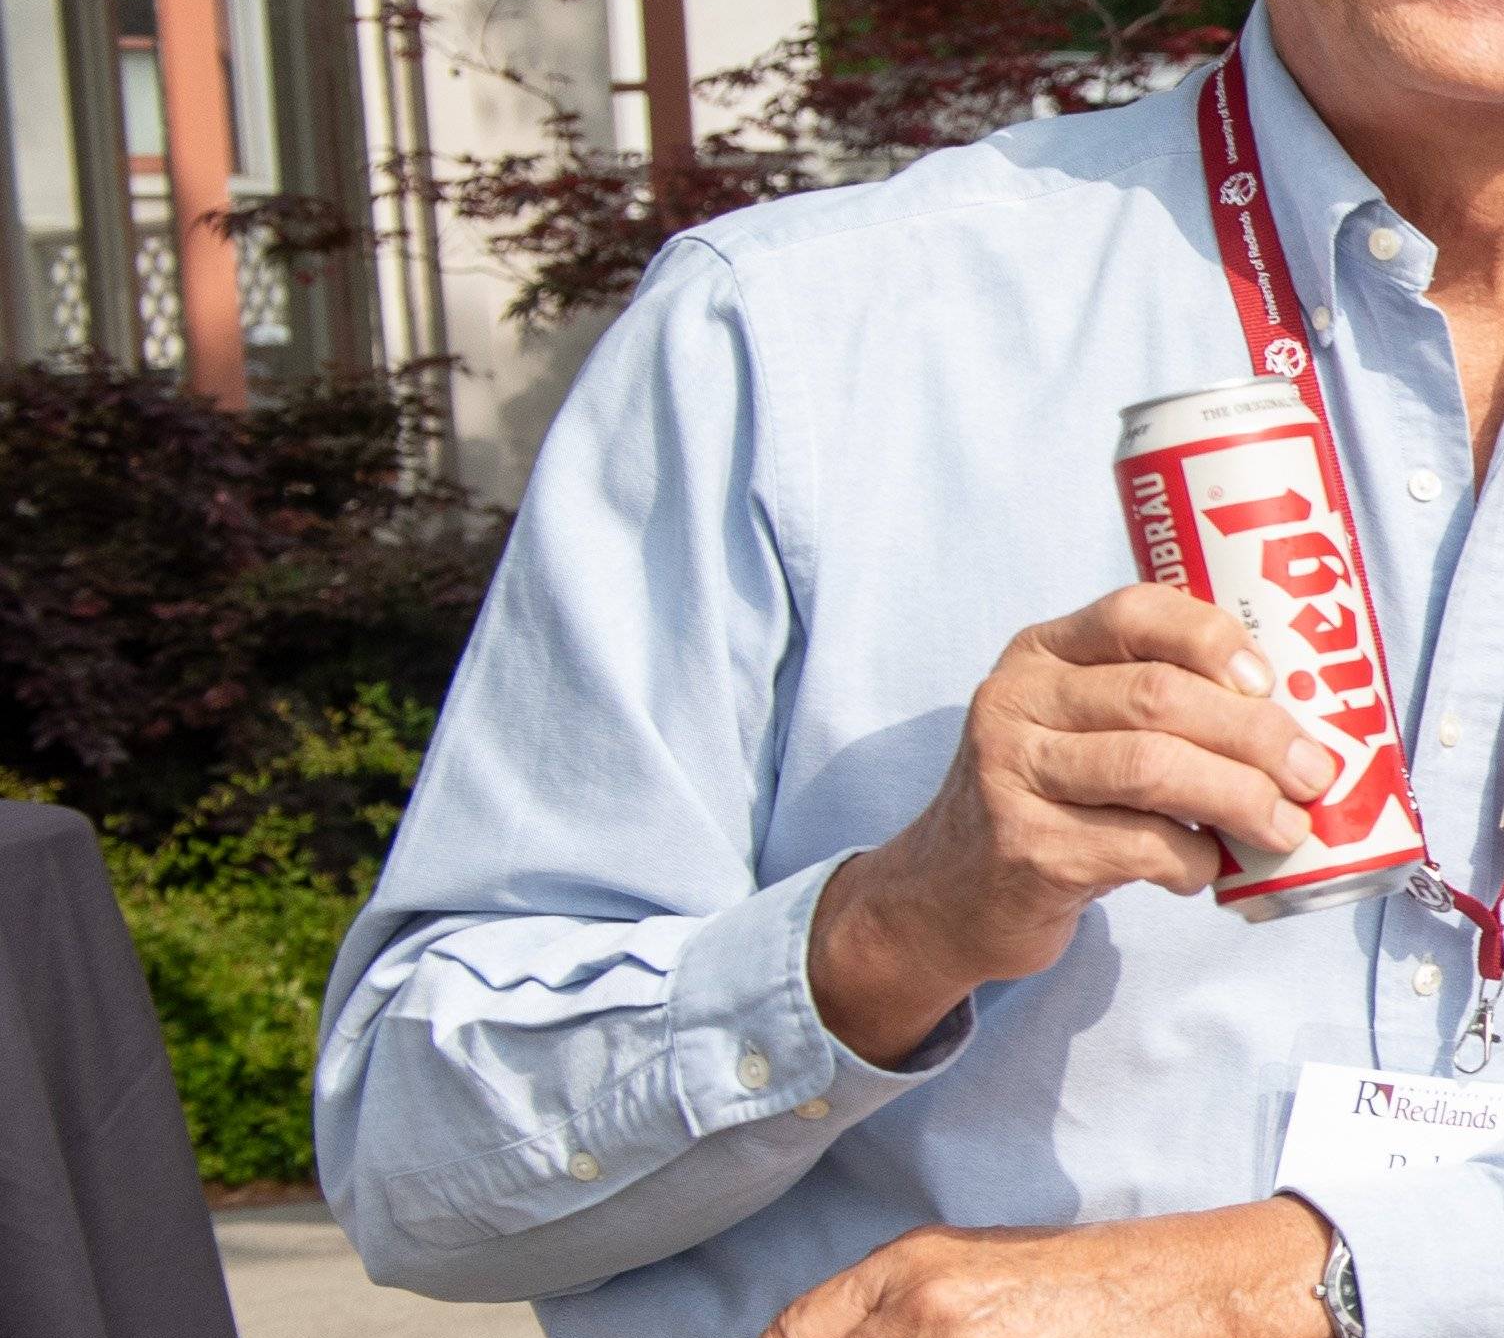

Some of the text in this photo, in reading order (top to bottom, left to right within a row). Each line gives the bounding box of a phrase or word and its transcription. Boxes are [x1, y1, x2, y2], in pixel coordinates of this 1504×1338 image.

[1132, 472, 1191, 596] DBRÄU
[1203, 488, 1422, 848] Stiegl
[1393, 1097, 1498, 1131] Redlands
